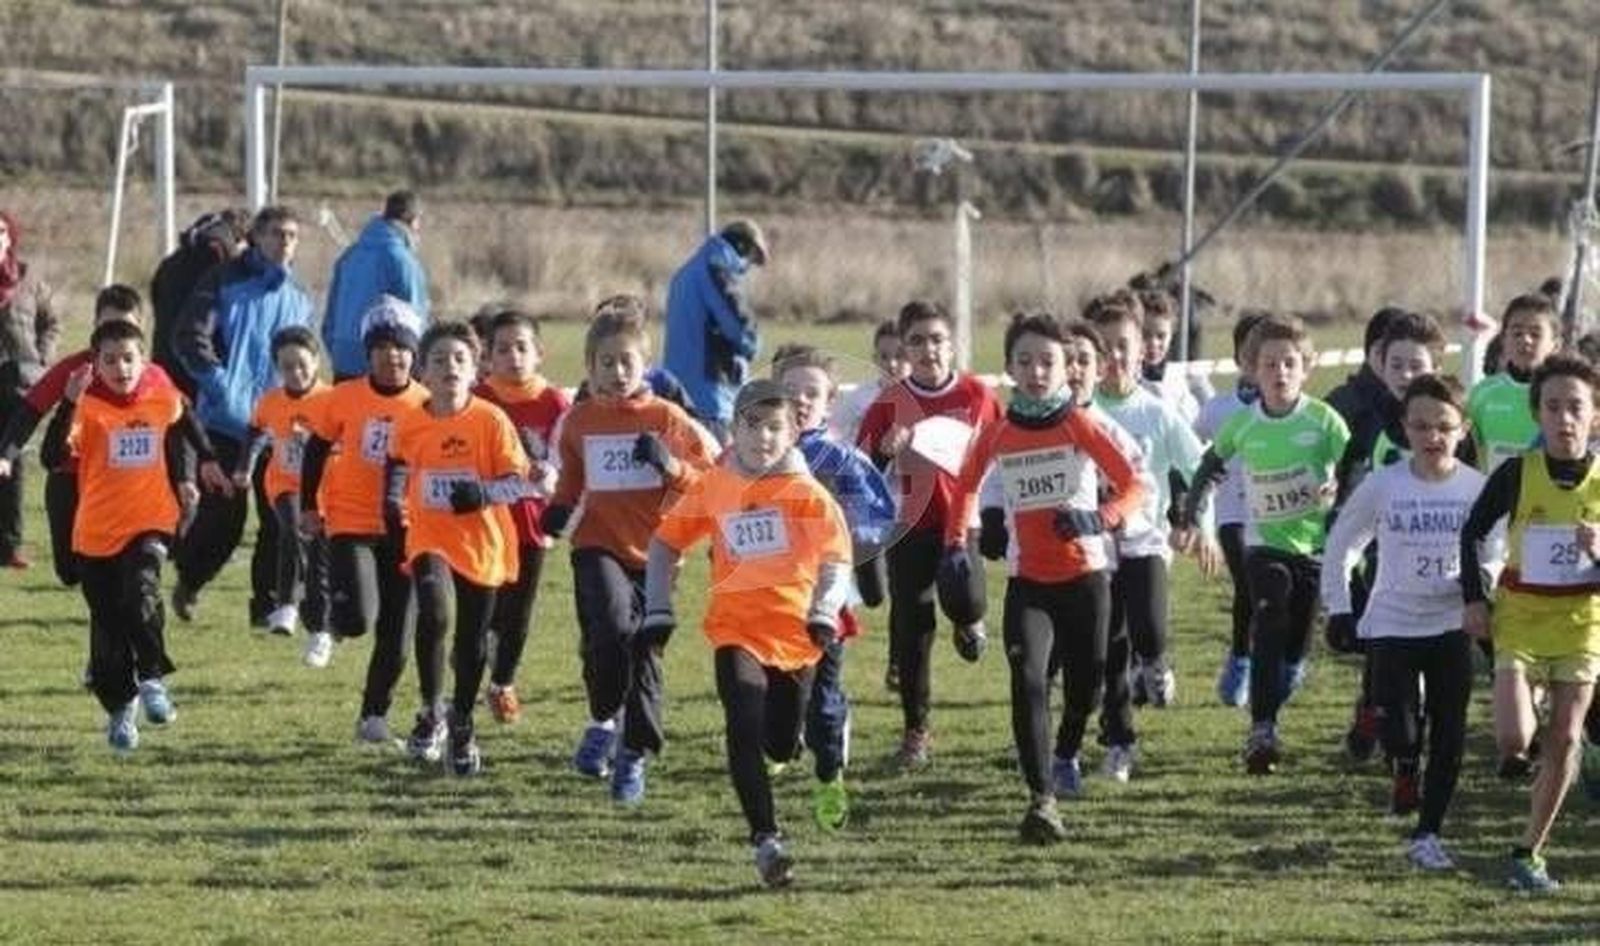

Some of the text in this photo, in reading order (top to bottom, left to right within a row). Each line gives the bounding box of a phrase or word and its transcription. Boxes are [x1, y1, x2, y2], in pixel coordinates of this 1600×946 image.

[1016, 473, 1066, 498] 2087
[1265, 485, 1311, 511] 2195
[735, 519, 775, 547] 2132
